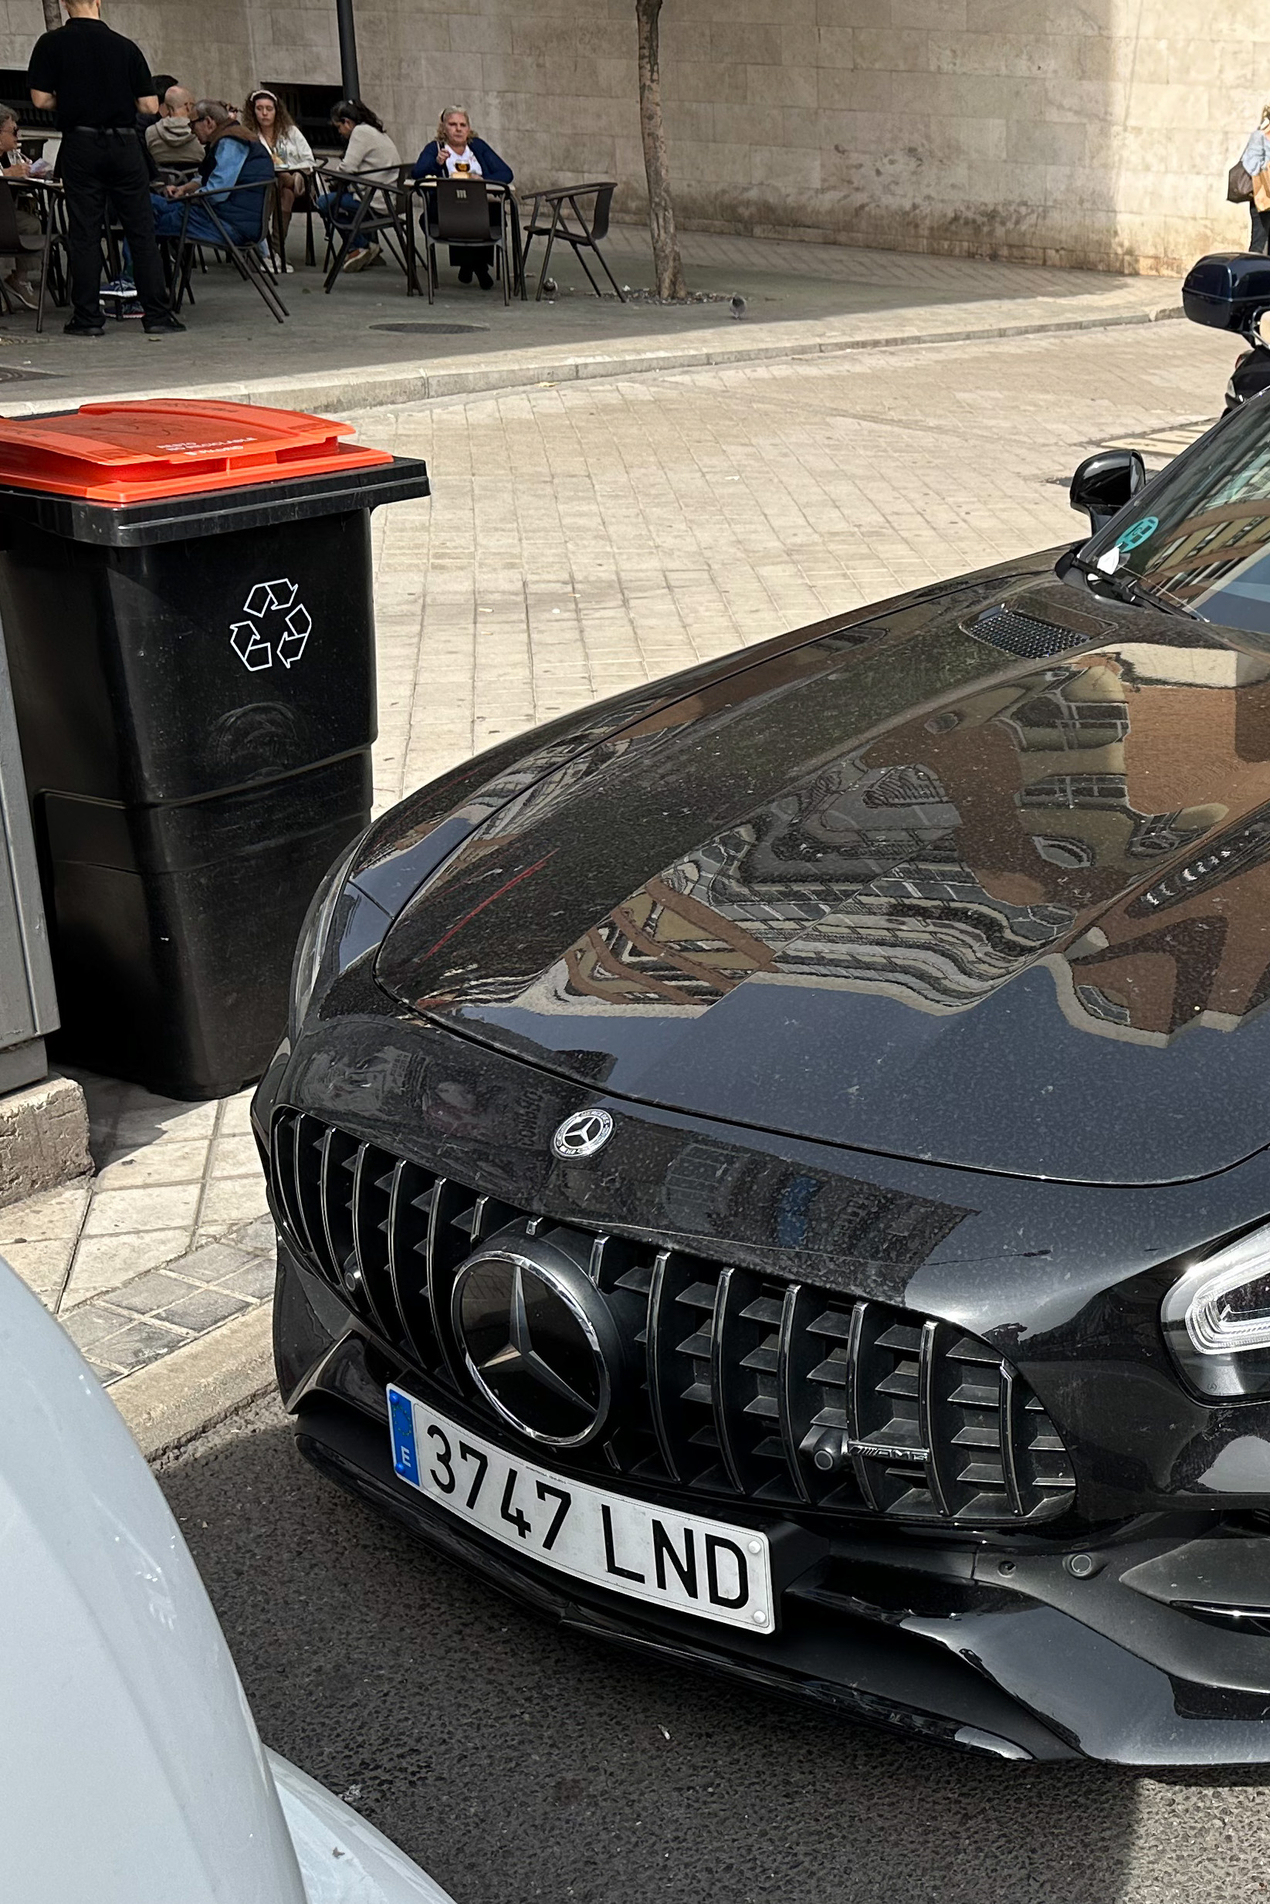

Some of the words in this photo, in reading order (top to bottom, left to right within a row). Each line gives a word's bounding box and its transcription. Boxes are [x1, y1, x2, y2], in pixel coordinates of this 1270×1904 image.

[400, 1444, 411, 1468] E
[426, 1424, 572, 1551] 3747
[601, 1503, 749, 1610] LND
